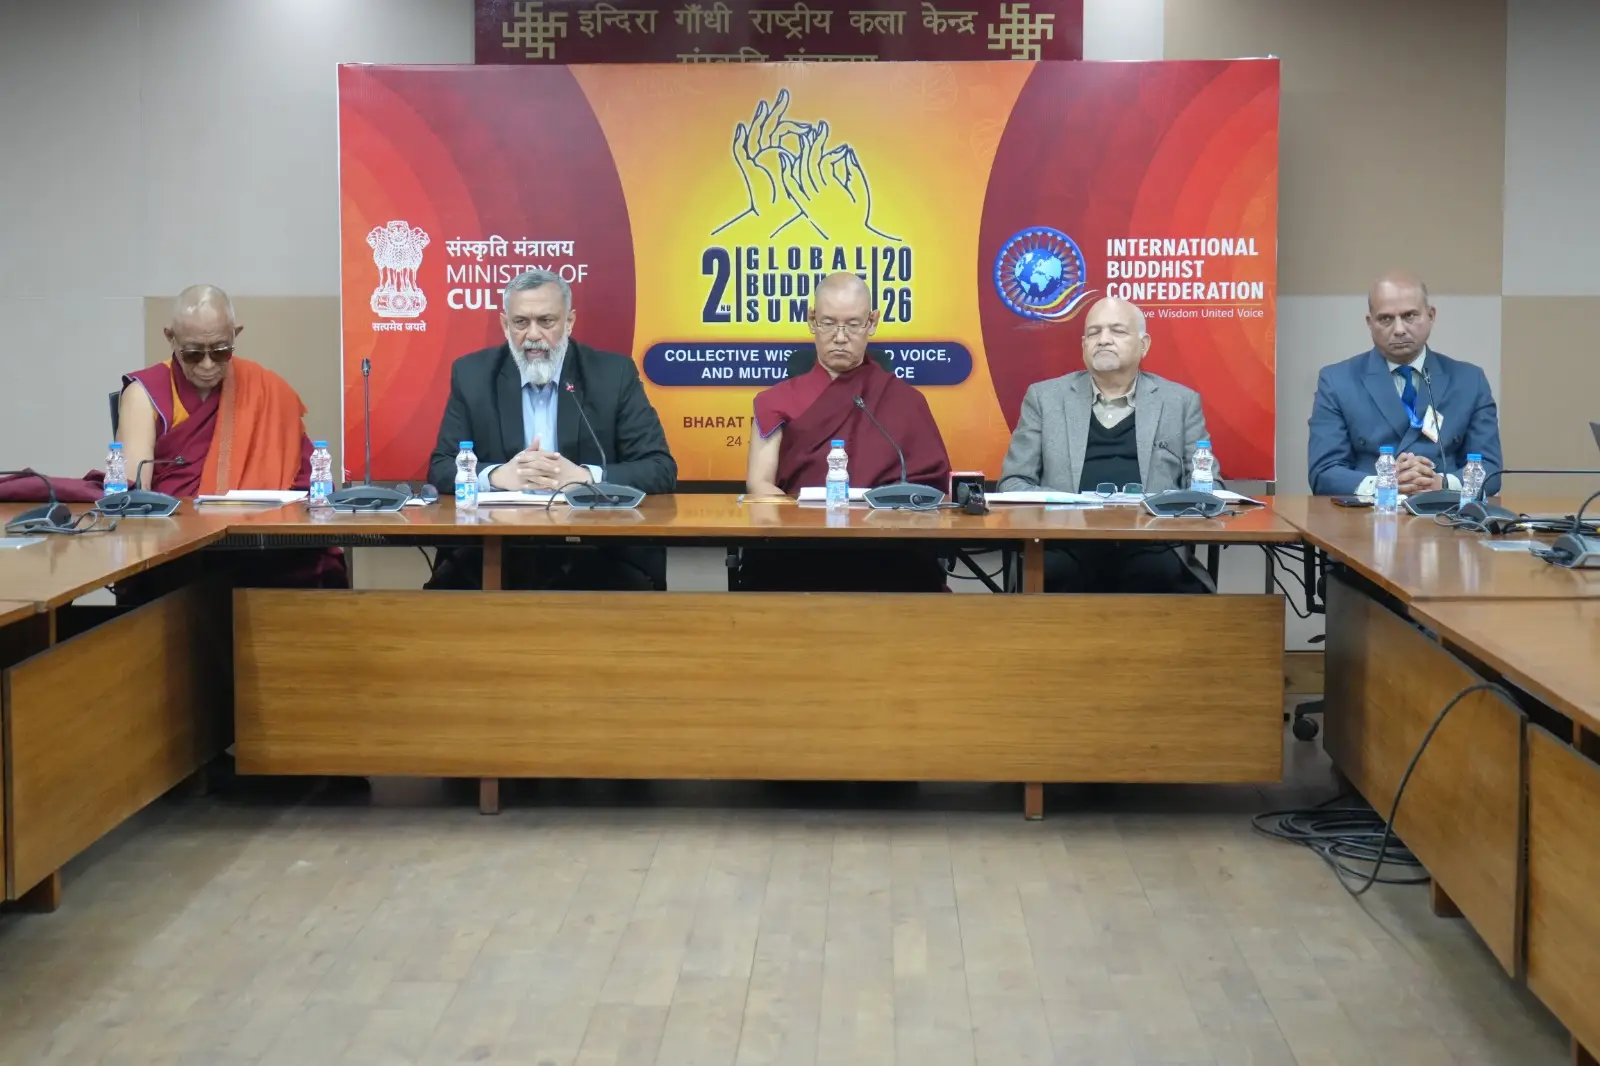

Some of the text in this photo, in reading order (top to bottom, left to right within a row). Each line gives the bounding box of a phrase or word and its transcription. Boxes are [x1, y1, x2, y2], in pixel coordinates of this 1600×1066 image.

[578, 3, 659, 38] इन्दिरा
[748, 2, 834, 40] राष्ट्रीय
[848, 10, 907, 36] कला
[921, 2, 979, 35] केन्द्र
[445, 235, 575, 262] संस्कृति मंत्रालय
[1107, 238, 1259, 257] INTERNATIONAL
[746, 246, 867, 270] GLOBAL
[559, 264, 588, 283] OF
[1107, 260, 1205, 279] BUDDHIST
[1106, 282, 1264, 300] CONFEDERATION
[746, 298, 809, 322] SUM
[1158, 308, 1198, 318] Wisdom
[1201, 308, 1234, 318] United
[1237, 308, 1264, 318] Voice
[371, 319, 427, 332] सत्यमेव जयते
[664, 349, 760, 362] COLLECTIVE
[764, 349, 798, 362] WIS
[900, 349, 951, 363] VOICE,
[701, 367, 789, 379] AND MUTUA
[683, 416, 745, 428] BHARAT
[726, 435, 742, 447] 24
